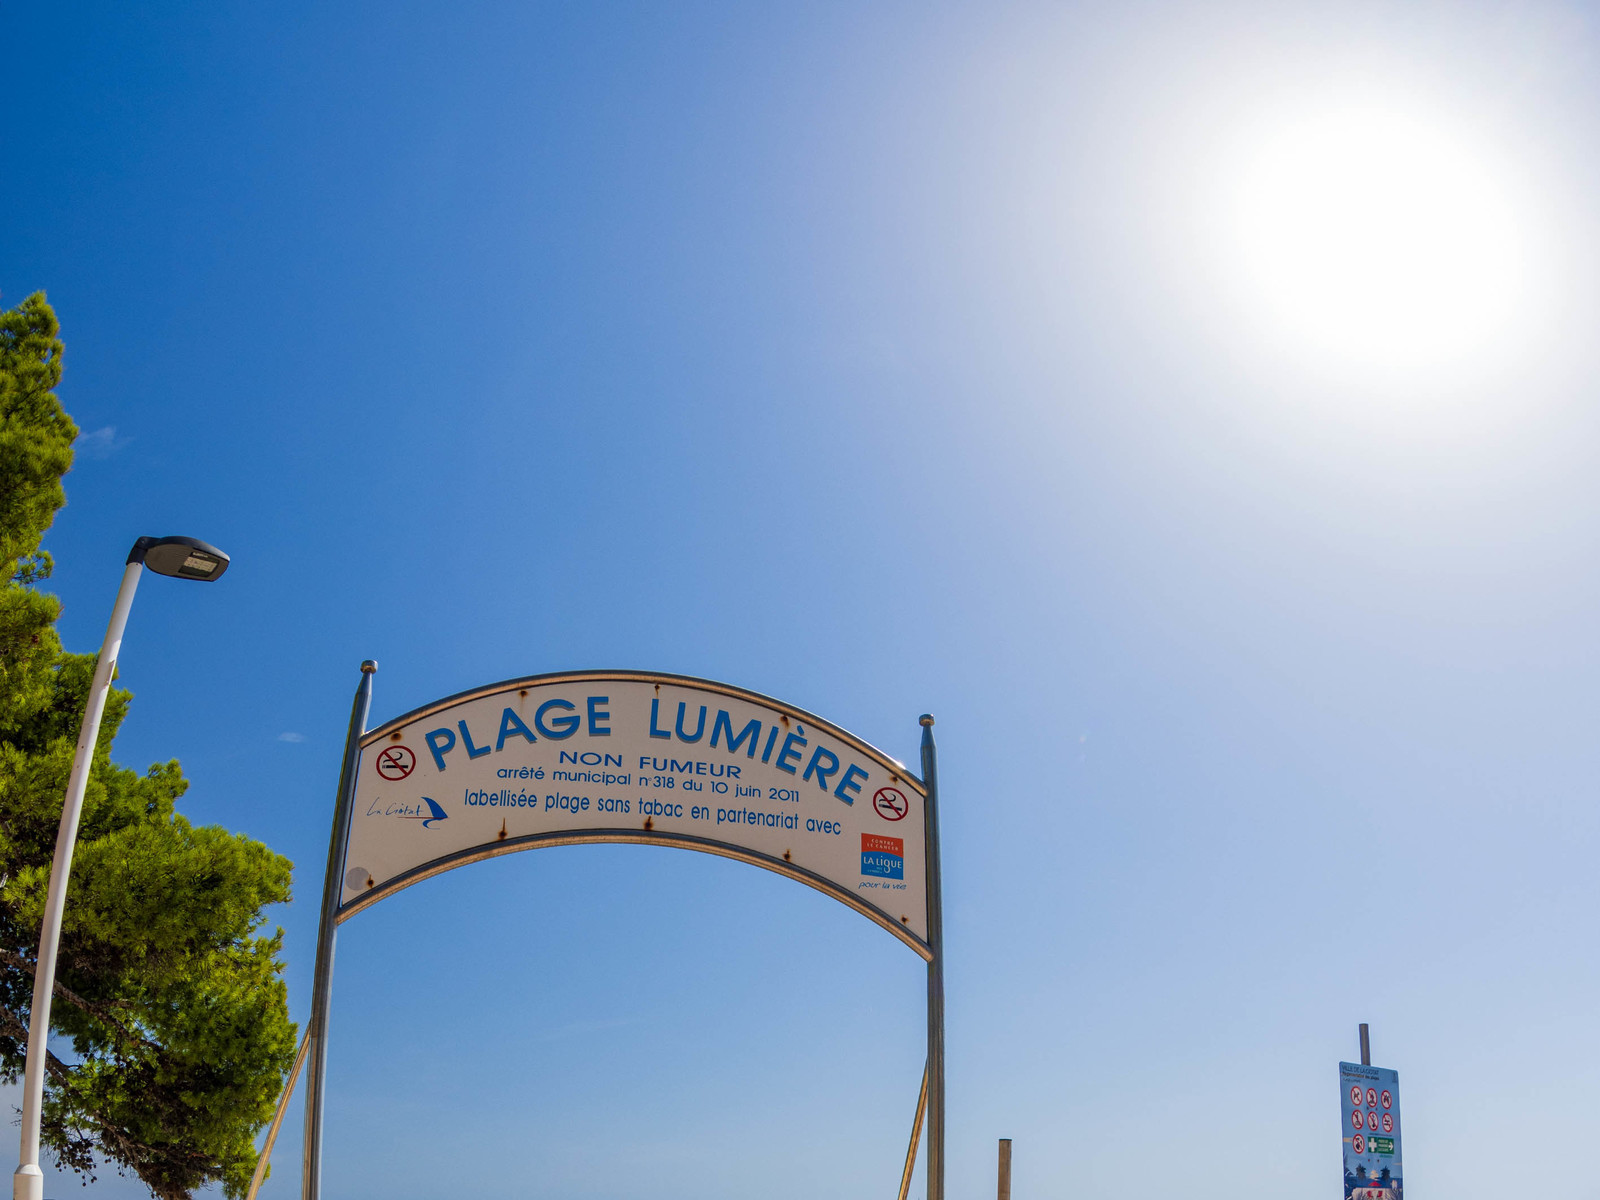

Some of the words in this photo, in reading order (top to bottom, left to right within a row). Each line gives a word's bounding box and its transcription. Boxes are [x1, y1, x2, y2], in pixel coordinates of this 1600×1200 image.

[424, 696, 612, 771] PLAGE
[649, 698, 870, 806] LUMIÈRE
[559, 750, 623, 768] NON
[639, 756, 742, 779] FUMEUR
[496, 766, 545, 780] arrêté
[552, 770, 631, 786] municipal
[682, 779, 703, 792] du
[710, 780, 728, 795] 10
[735, 782, 761, 798] juin
[768, 787, 800, 803] 2011
[464, 788, 538, 808] labellisée
[544, 791, 590, 814] plage
[597, 797, 631, 814] sans
[638, 798, 683, 818] tabac
[690, 805, 710, 820] en
[716, 806, 799, 830] partenariat
[805, 818, 841, 836] avec
[863, 856, 874, 865] LA
